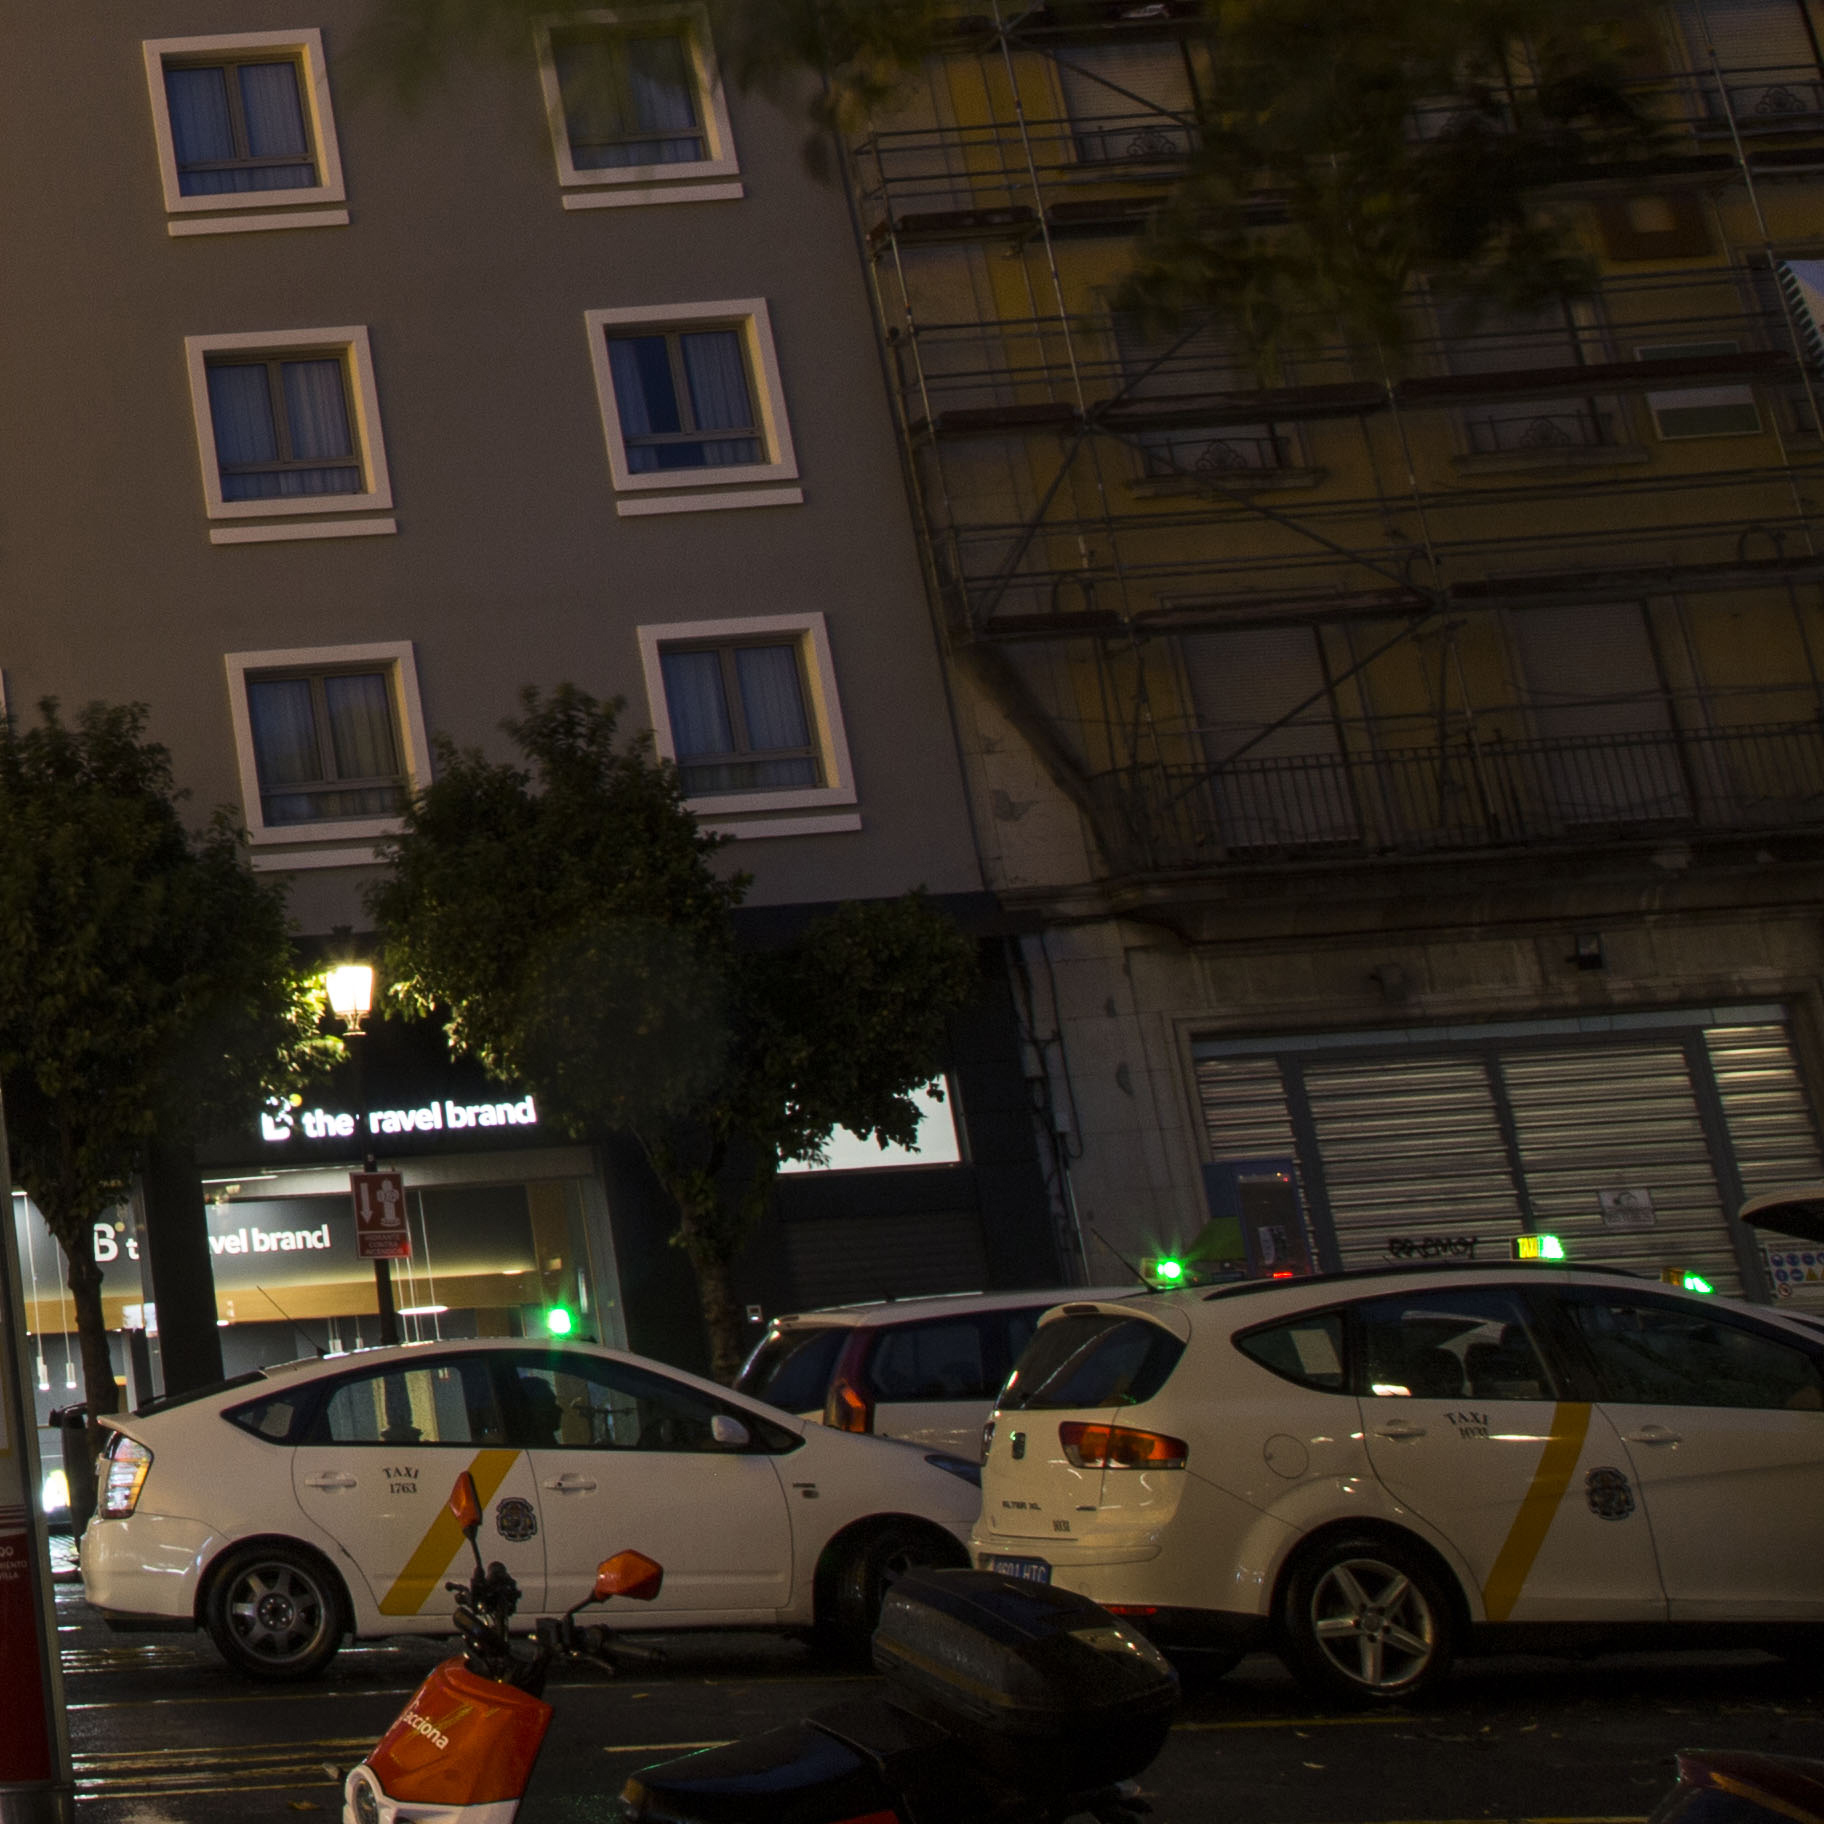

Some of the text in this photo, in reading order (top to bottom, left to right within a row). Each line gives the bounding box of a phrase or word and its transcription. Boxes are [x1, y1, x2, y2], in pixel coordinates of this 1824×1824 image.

[302, 1107, 356, 1140] the
[356, 1101, 442, 1135] ravel
[445, 1094, 539, 1131] brand
[93, 1222, 119, 1263] B
[251, 1223, 331, 1252] brand
[1443, 1410, 1489, 1426] TAXI
[383, 1466, 420, 1480] TAXI
[389, 1482, 417, 1494] 1763
[403, 1710, 449, 1750] acciona
